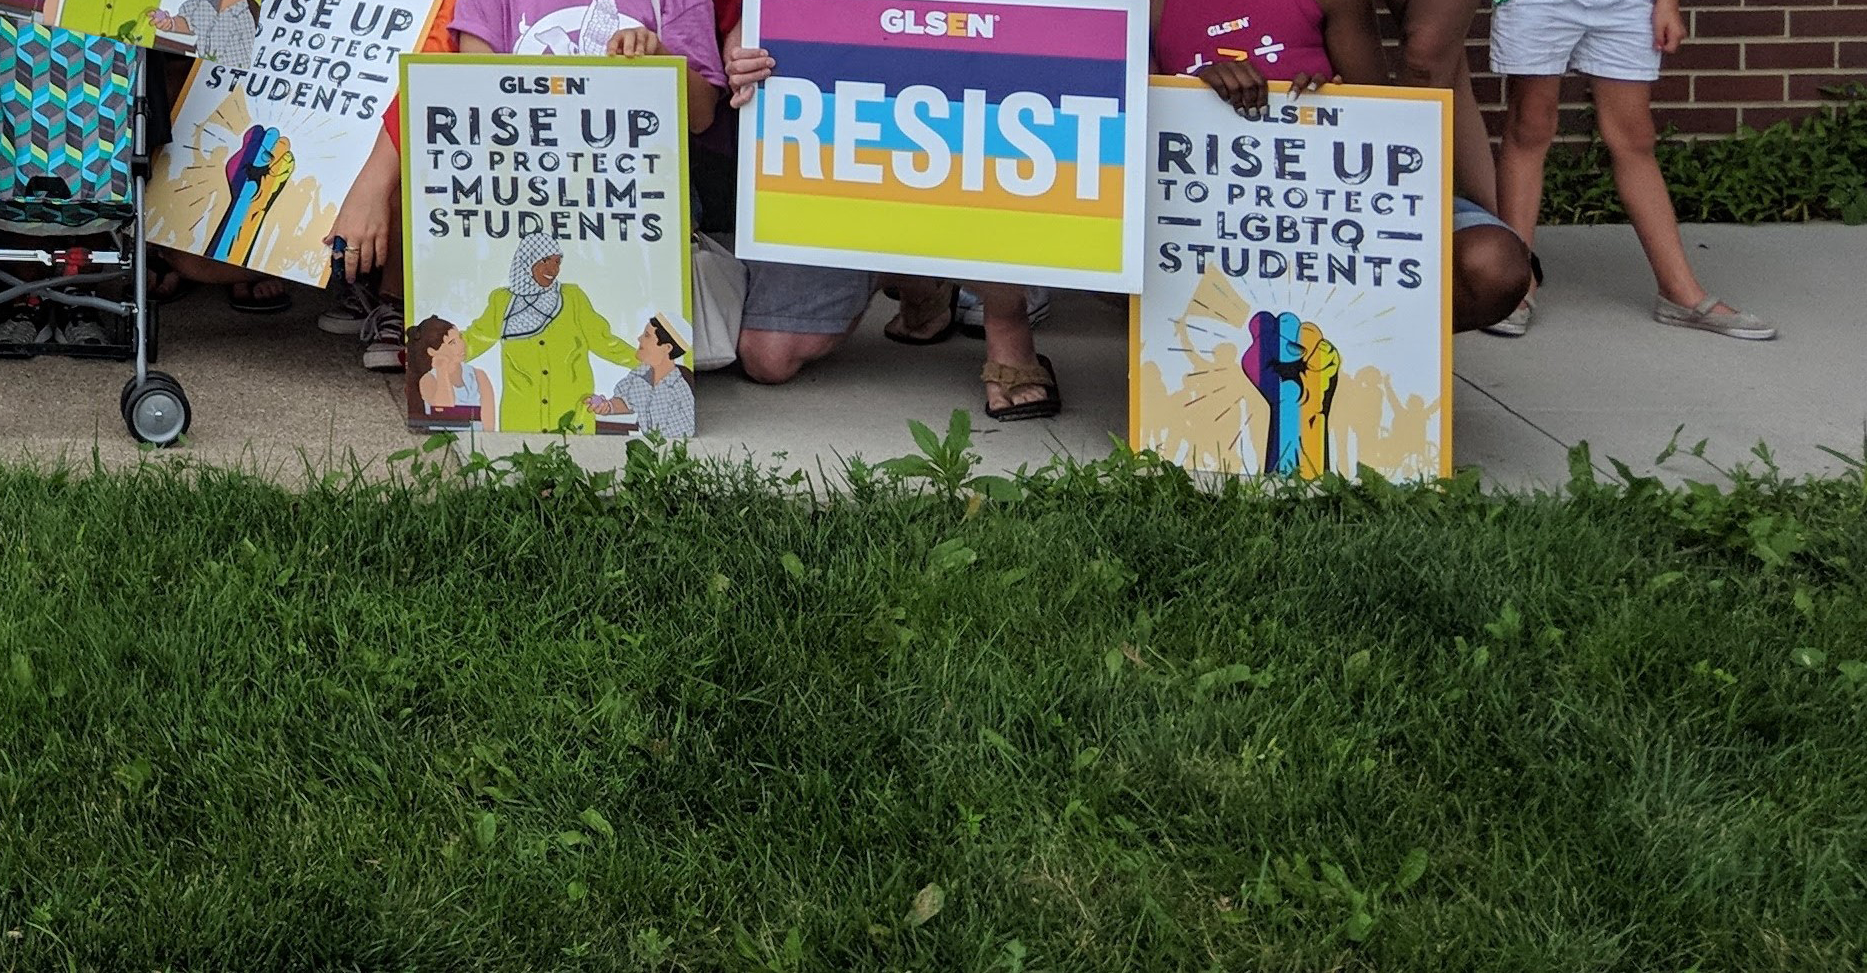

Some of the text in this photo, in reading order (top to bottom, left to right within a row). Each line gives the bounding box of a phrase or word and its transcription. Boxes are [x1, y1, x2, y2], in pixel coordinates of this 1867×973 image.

[352, 1, 413, 41] UP
[880, 8, 994, 39] GLSEN
[1207, 16, 1249, 37] GLSEN
[272, 27, 401, 64] PROTECT
[254, 46, 352, 88] LGBTQ
[499, 76, 586, 95] GLSEN
[206, 65, 378, 121] STUDENTS
[426, 106, 660, 150] RISE UP
[1244, 105, 1338, 127] LSEN
[762, 76, 1120, 201] RESIST
[427, 149, 661, 175] TO PROTECT
[1158, 131, 1424, 187] RISE UP
[451, 175, 637, 209] MUSLIM
[1158, 179, 1424, 216] TO PROTECT
[429, 207, 663, 242] STUDENTS
[1217, 211, 1364, 254] LGBTQ
[1159, 242, 1422, 289] STUDENTS
